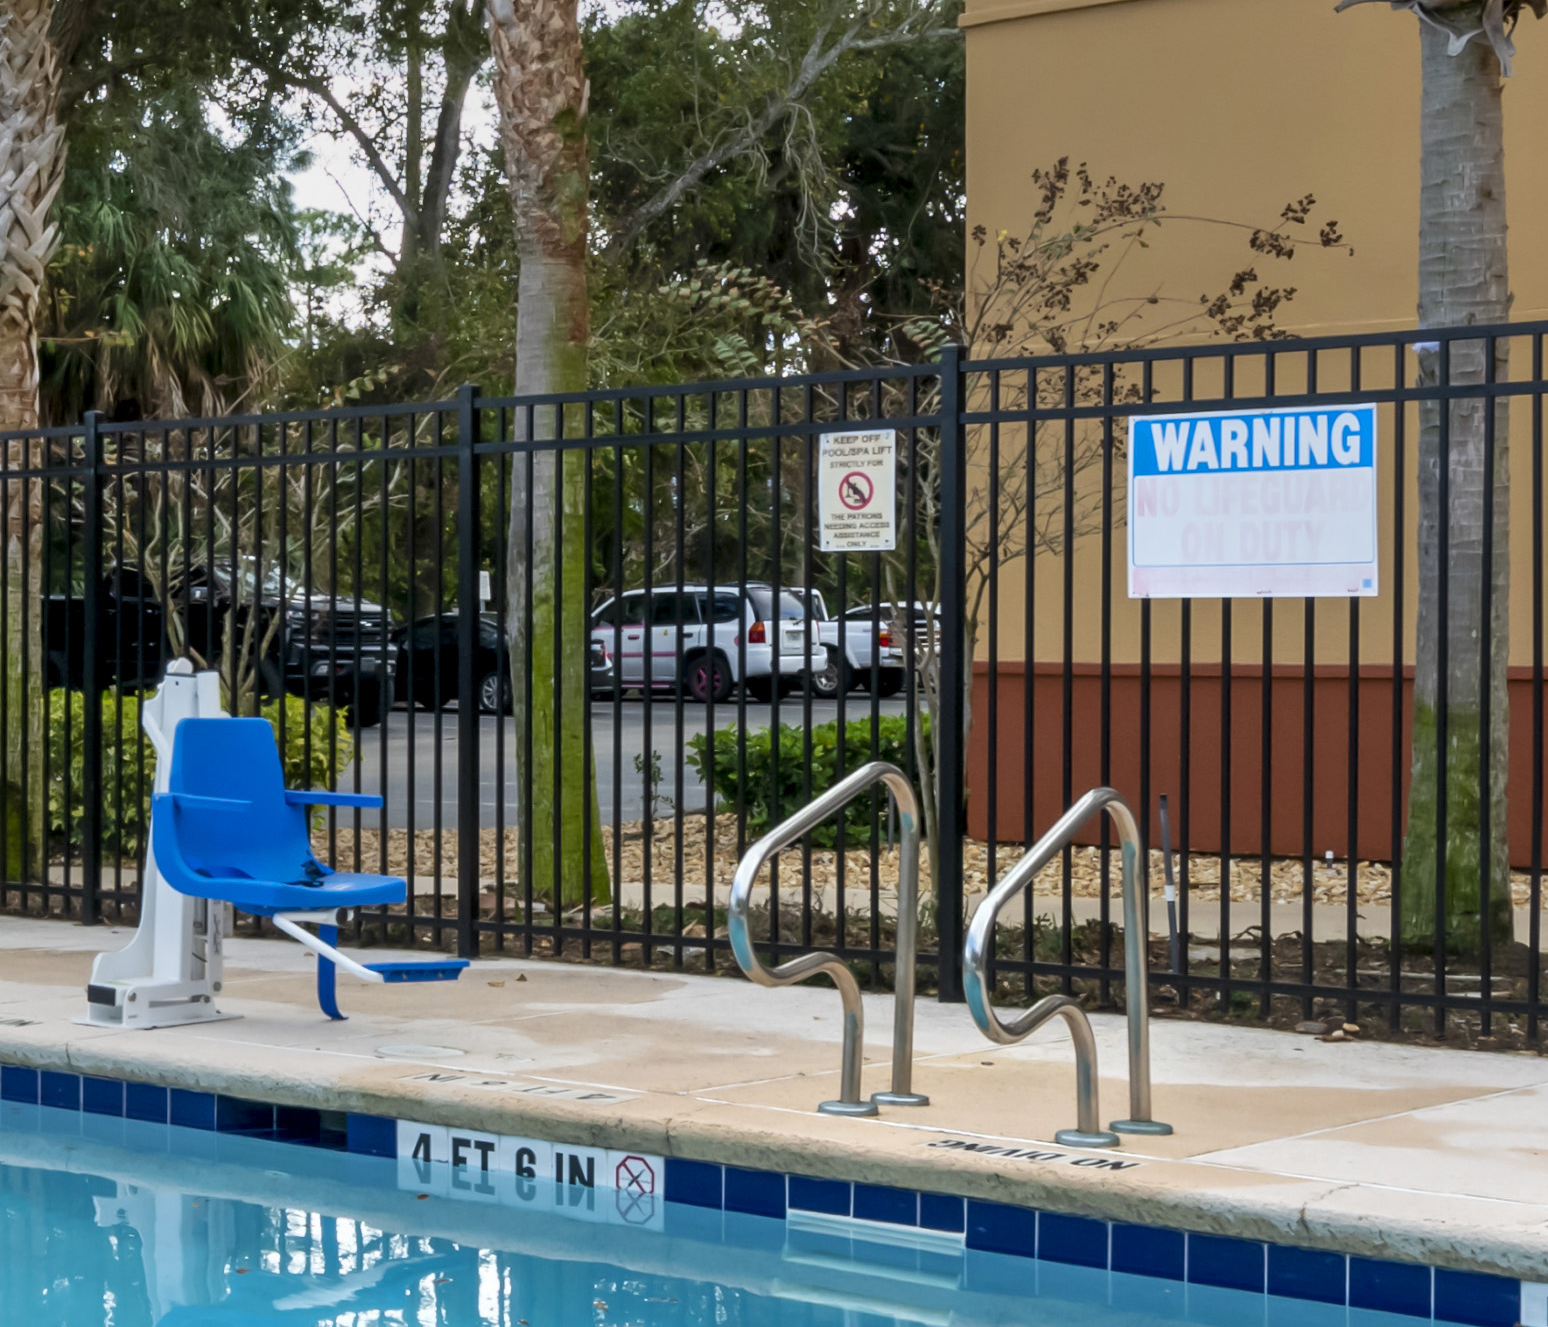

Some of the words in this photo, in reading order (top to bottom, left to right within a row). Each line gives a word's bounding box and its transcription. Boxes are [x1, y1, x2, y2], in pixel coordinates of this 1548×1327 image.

[833, 436, 859, 445] KEEP
[862, 435, 881, 443] OFF
[1150, 412, 1361, 472] WARNING
[822, 447, 870, 457] POOL/SPA
[872, 445, 892, 455] LIFT
[928, 1139, 1066, 1161] DIVING
[556, 1152, 594, 1187] IN
[1070, 1157, 1141, 1171] NO
